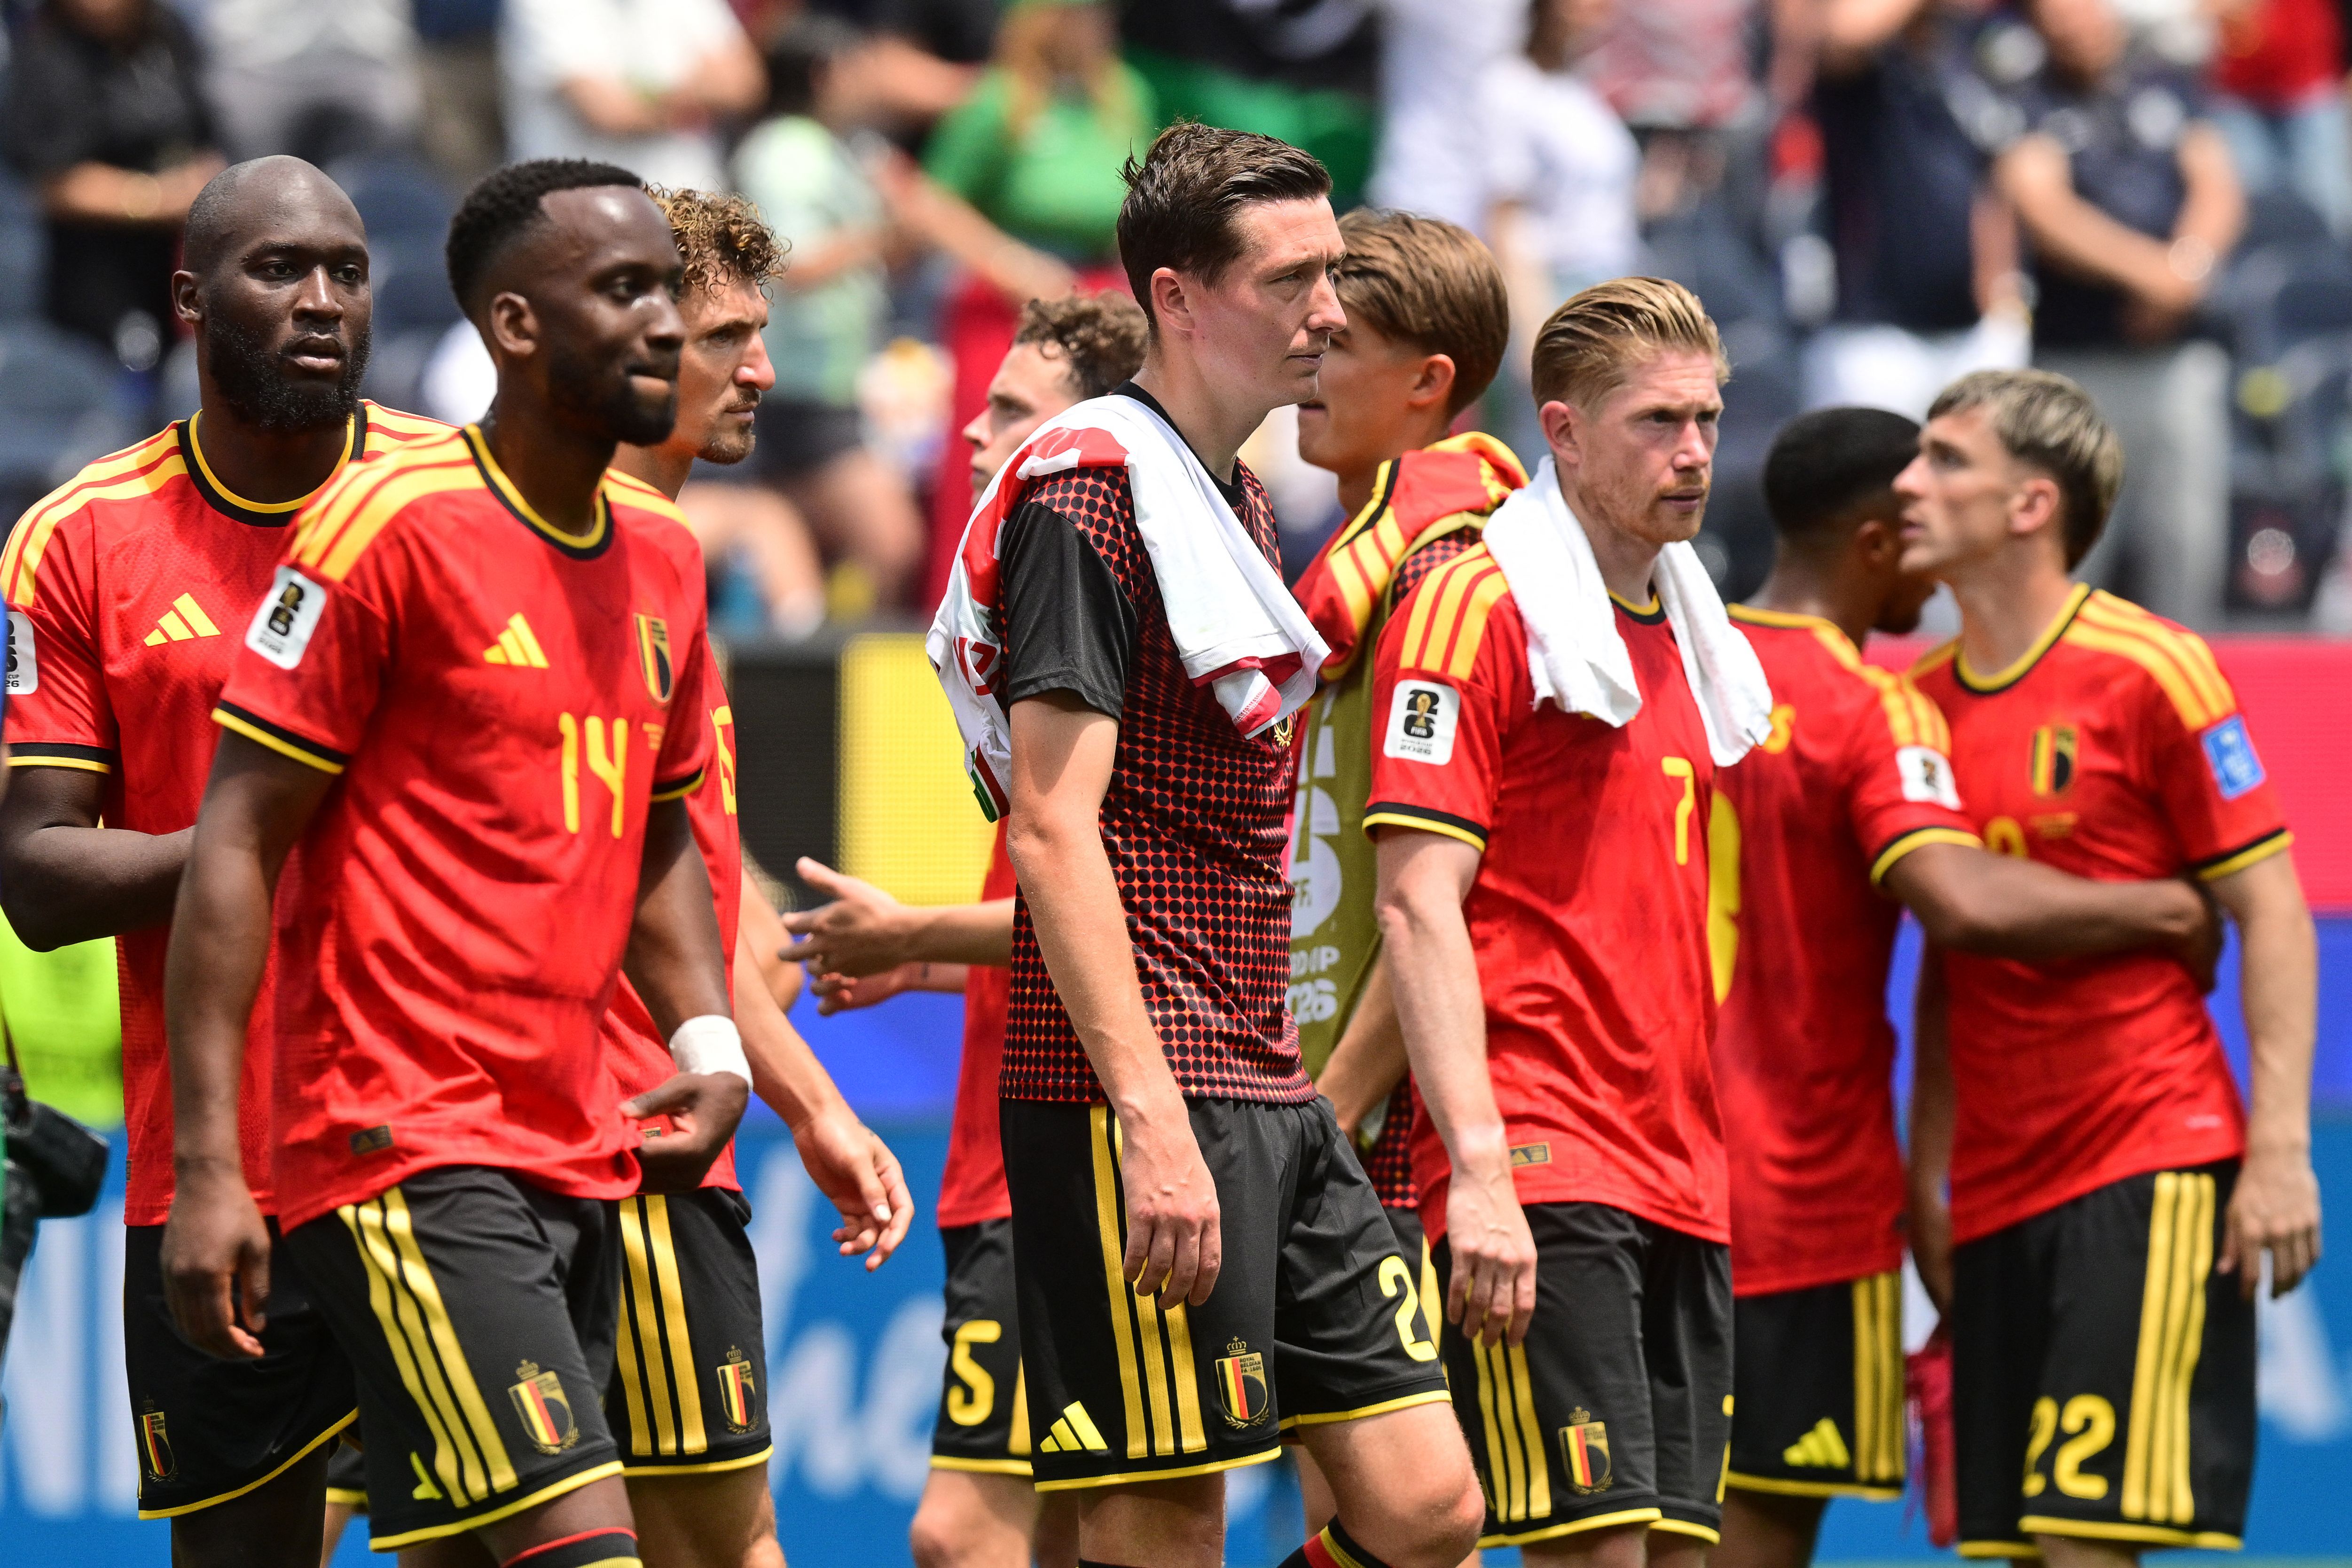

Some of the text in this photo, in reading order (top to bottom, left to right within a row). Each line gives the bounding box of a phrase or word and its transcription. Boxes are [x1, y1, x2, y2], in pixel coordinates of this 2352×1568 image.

[558, 711, 628, 839] 14
[1661, 756, 1694, 866] 7
[1378, 1255, 1438, 1362] 2
[947, 1319, 1002, 1426] 5
[2022, 1393, 2116, 1500] 22
